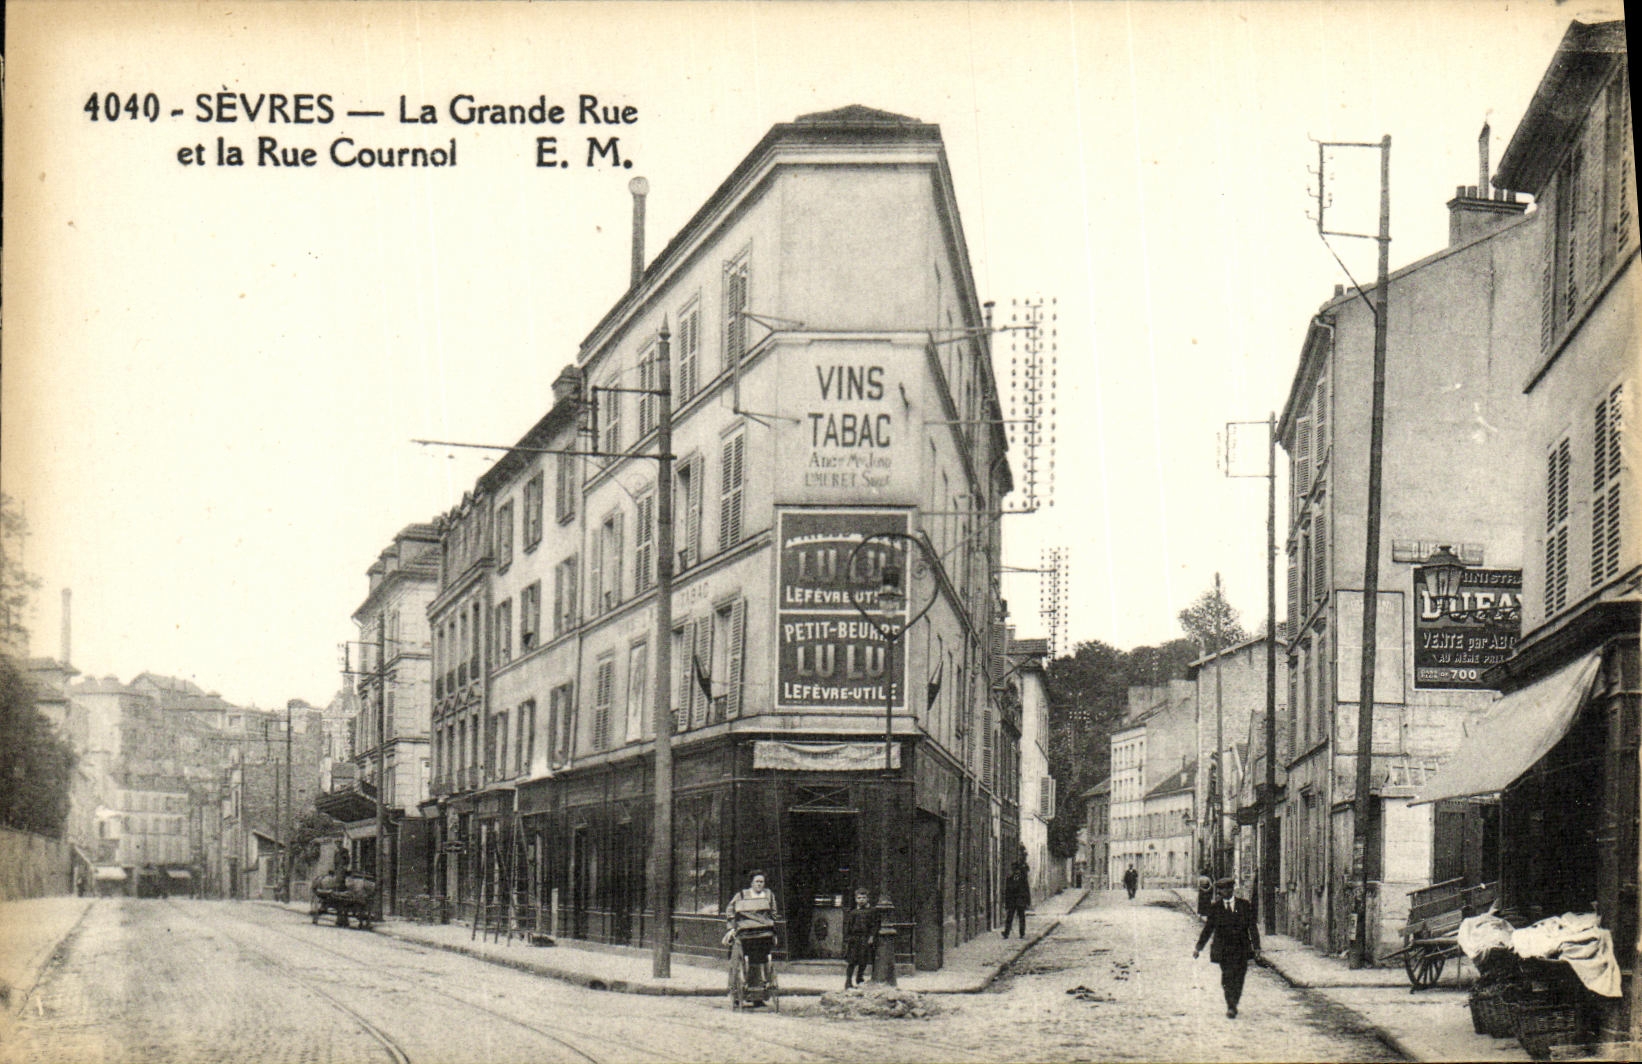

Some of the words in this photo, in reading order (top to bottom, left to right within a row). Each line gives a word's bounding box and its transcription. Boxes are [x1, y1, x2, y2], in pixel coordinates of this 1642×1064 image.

[816, 366, 884, 401] VINS
[807, 412, 891, 448] TABAC
[1421, 590, 1523, 620] DUFA
[1423, 632, 1464, 649] VENTE
[1469, 637, 1488, 651] par
[1450, 668, 1477, 680] 700
